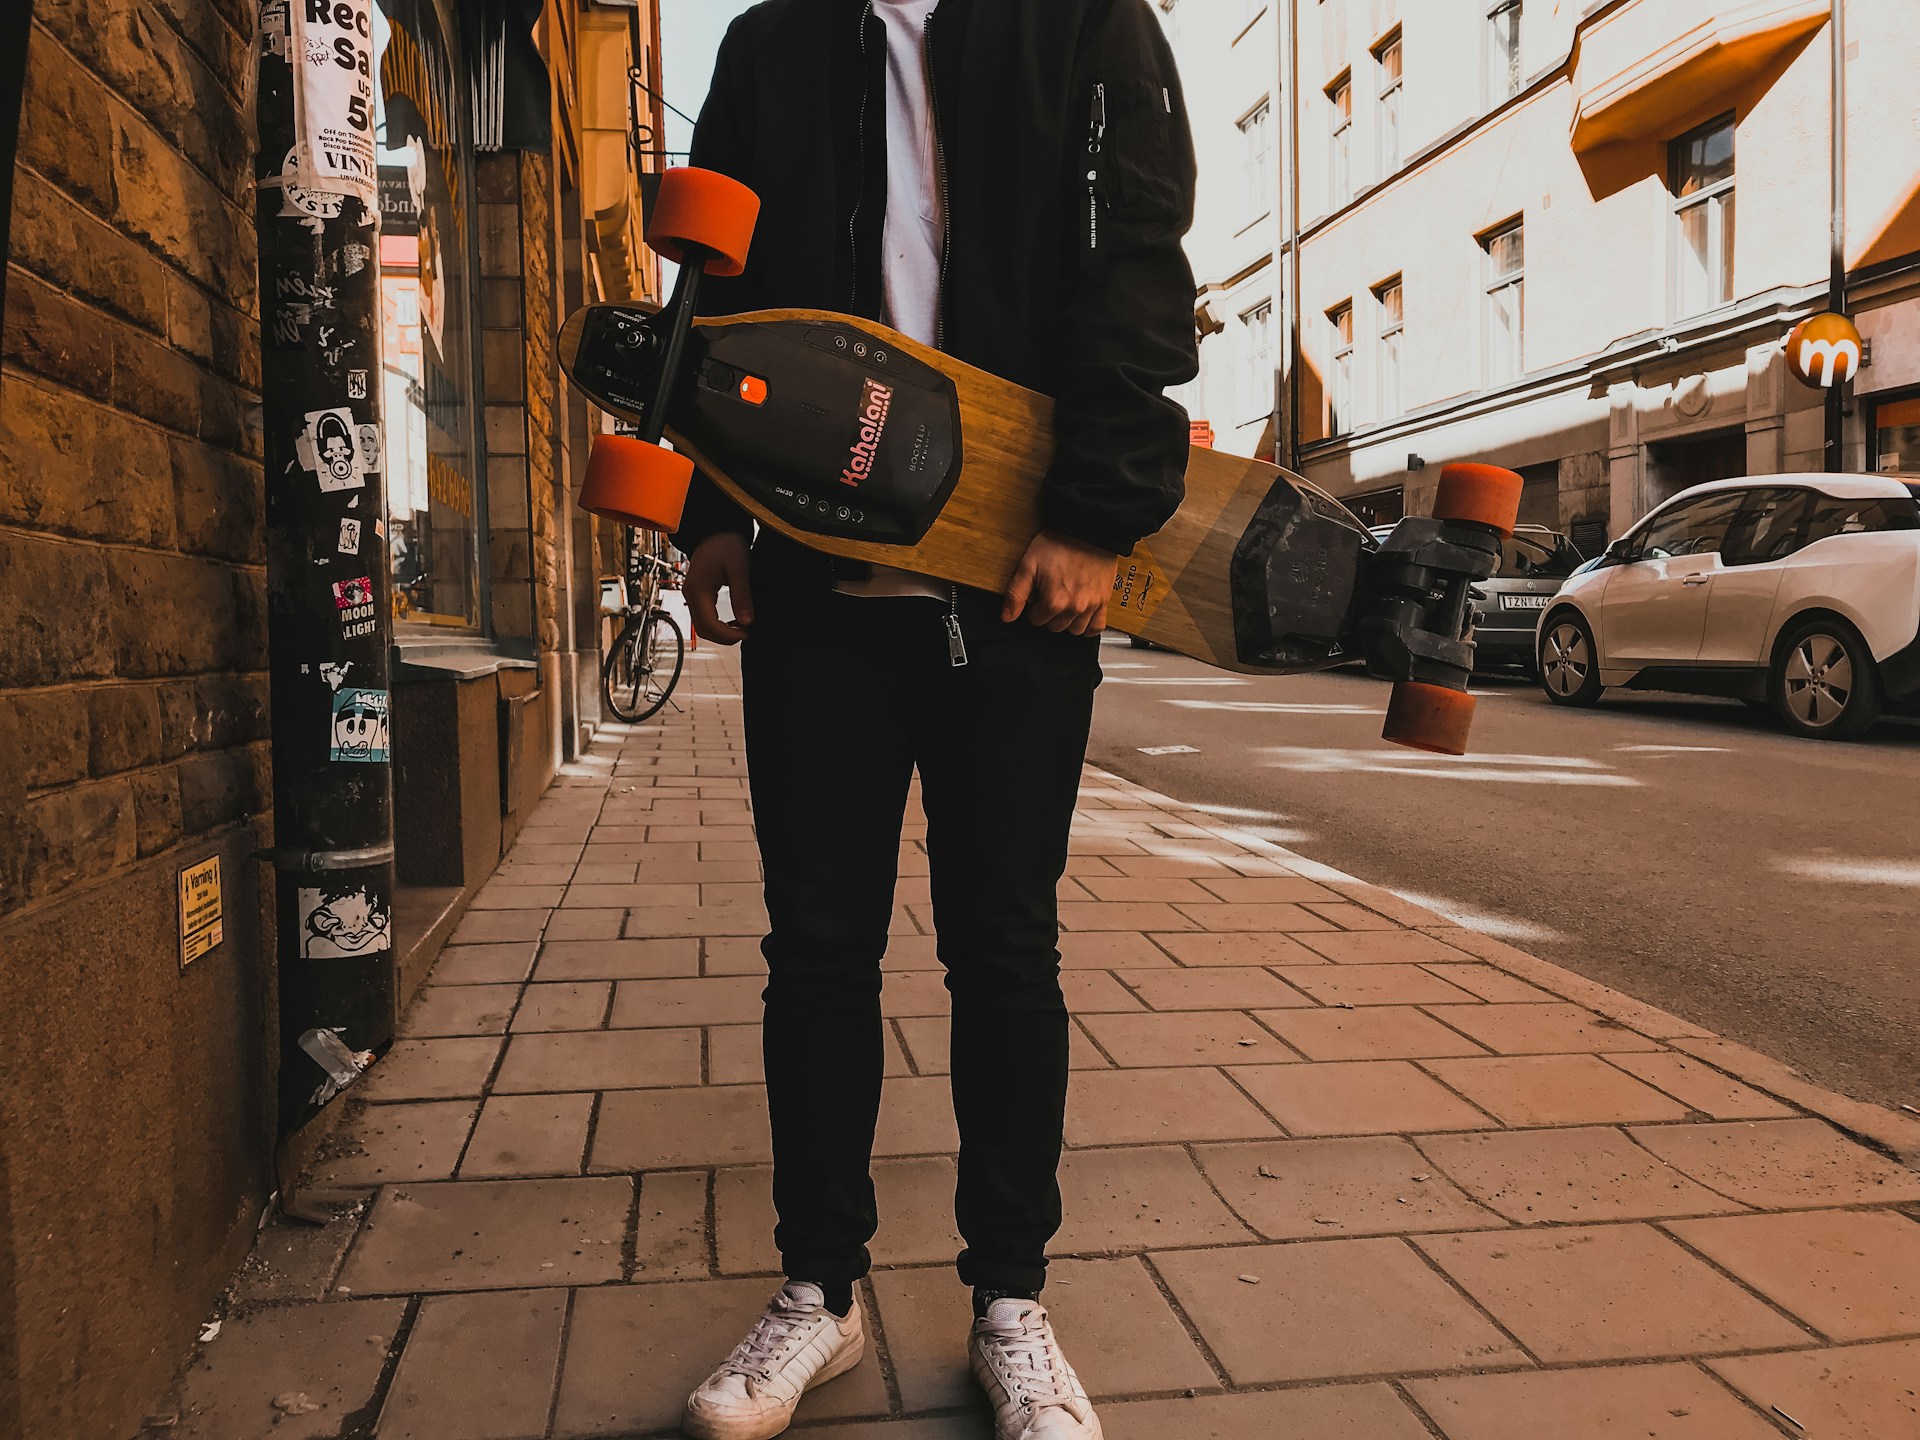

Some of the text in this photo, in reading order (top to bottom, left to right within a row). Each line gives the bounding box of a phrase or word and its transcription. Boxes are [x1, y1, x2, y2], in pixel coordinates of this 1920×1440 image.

[305, 0, 370, 38] Rec
[323, 128, 337, 136] Off
[323, 142, 341, 150] Disco
[840, 380, 891, 487] Kahalani
[909, 424, 926, 472] BOOSTED
[1120, 565, 1137, 607] BOOSTED
[1508, 596, 1528, 607] TZN
[341, 603, 375, 622] MOON
[345, 620, 376, 638] LIGHT
[190, 868, 213, 890] Varning
